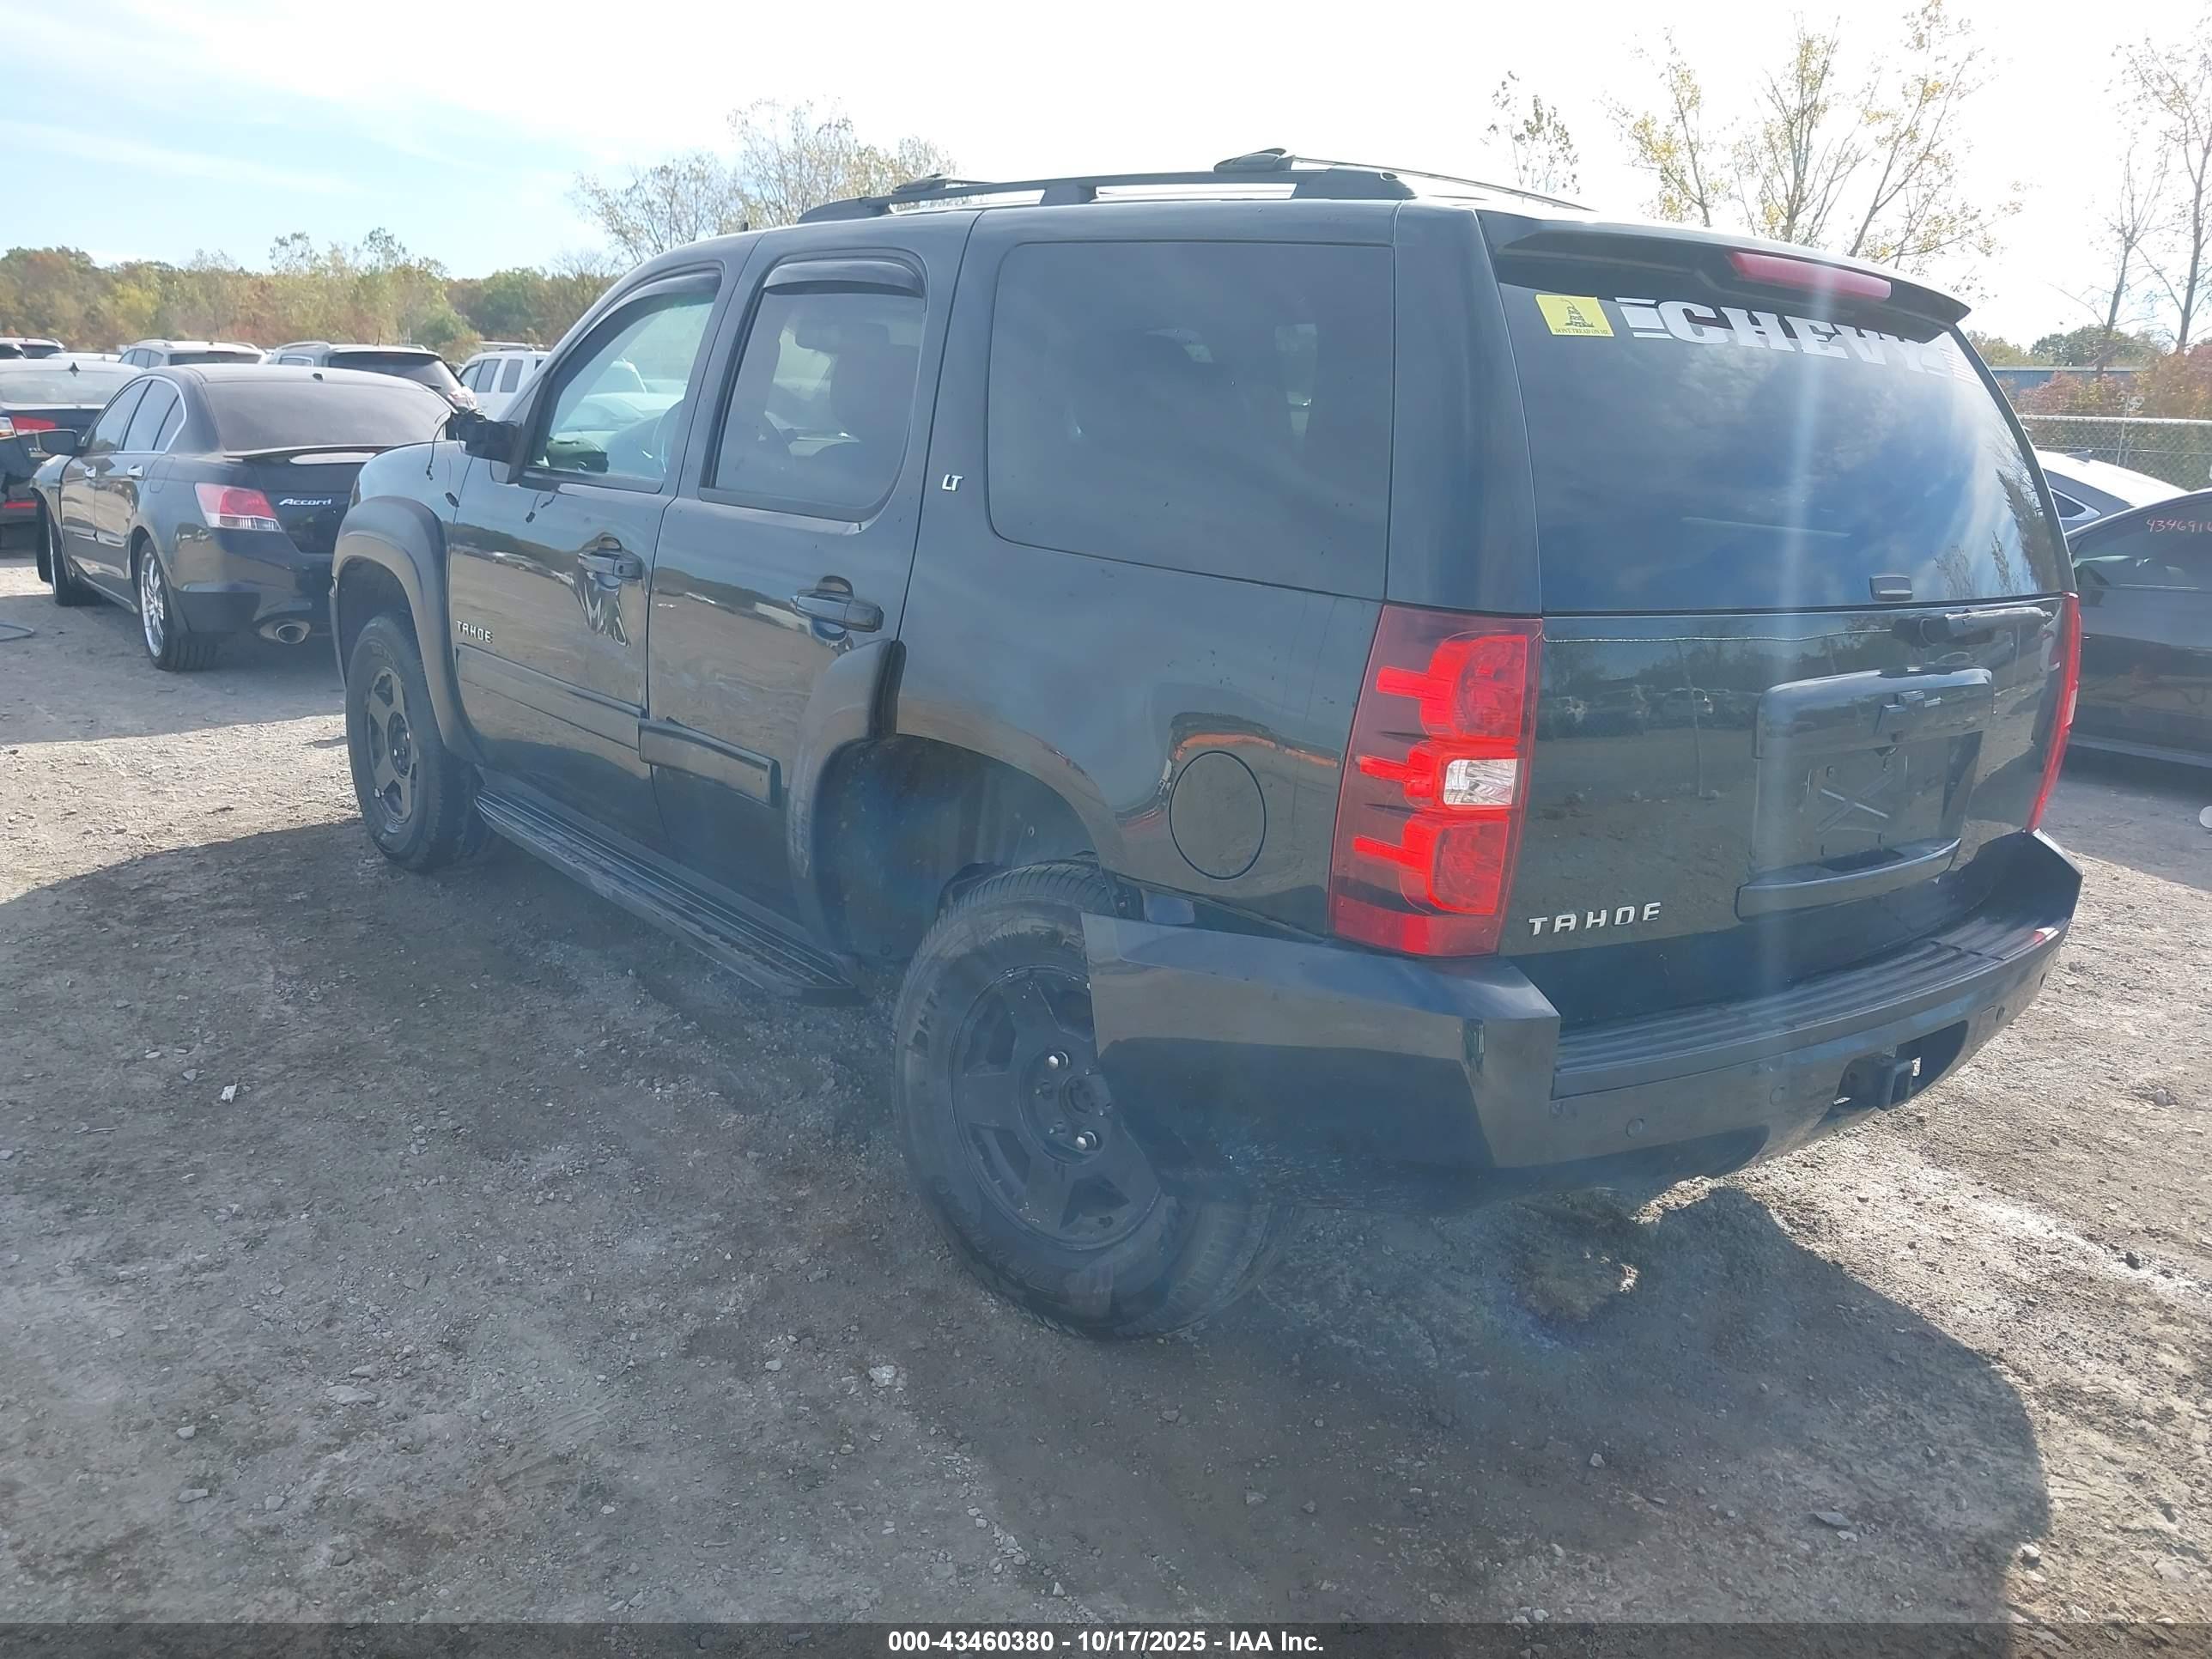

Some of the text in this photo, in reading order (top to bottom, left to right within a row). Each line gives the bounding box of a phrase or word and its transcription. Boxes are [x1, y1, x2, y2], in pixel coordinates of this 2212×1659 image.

[1656, 300, 1927, 374] CHEVY
[942, 474, 963, 491] LT
[456, 620, 493, 644] TAHOE
[1528, 902, 1662, 936] TAHOE
